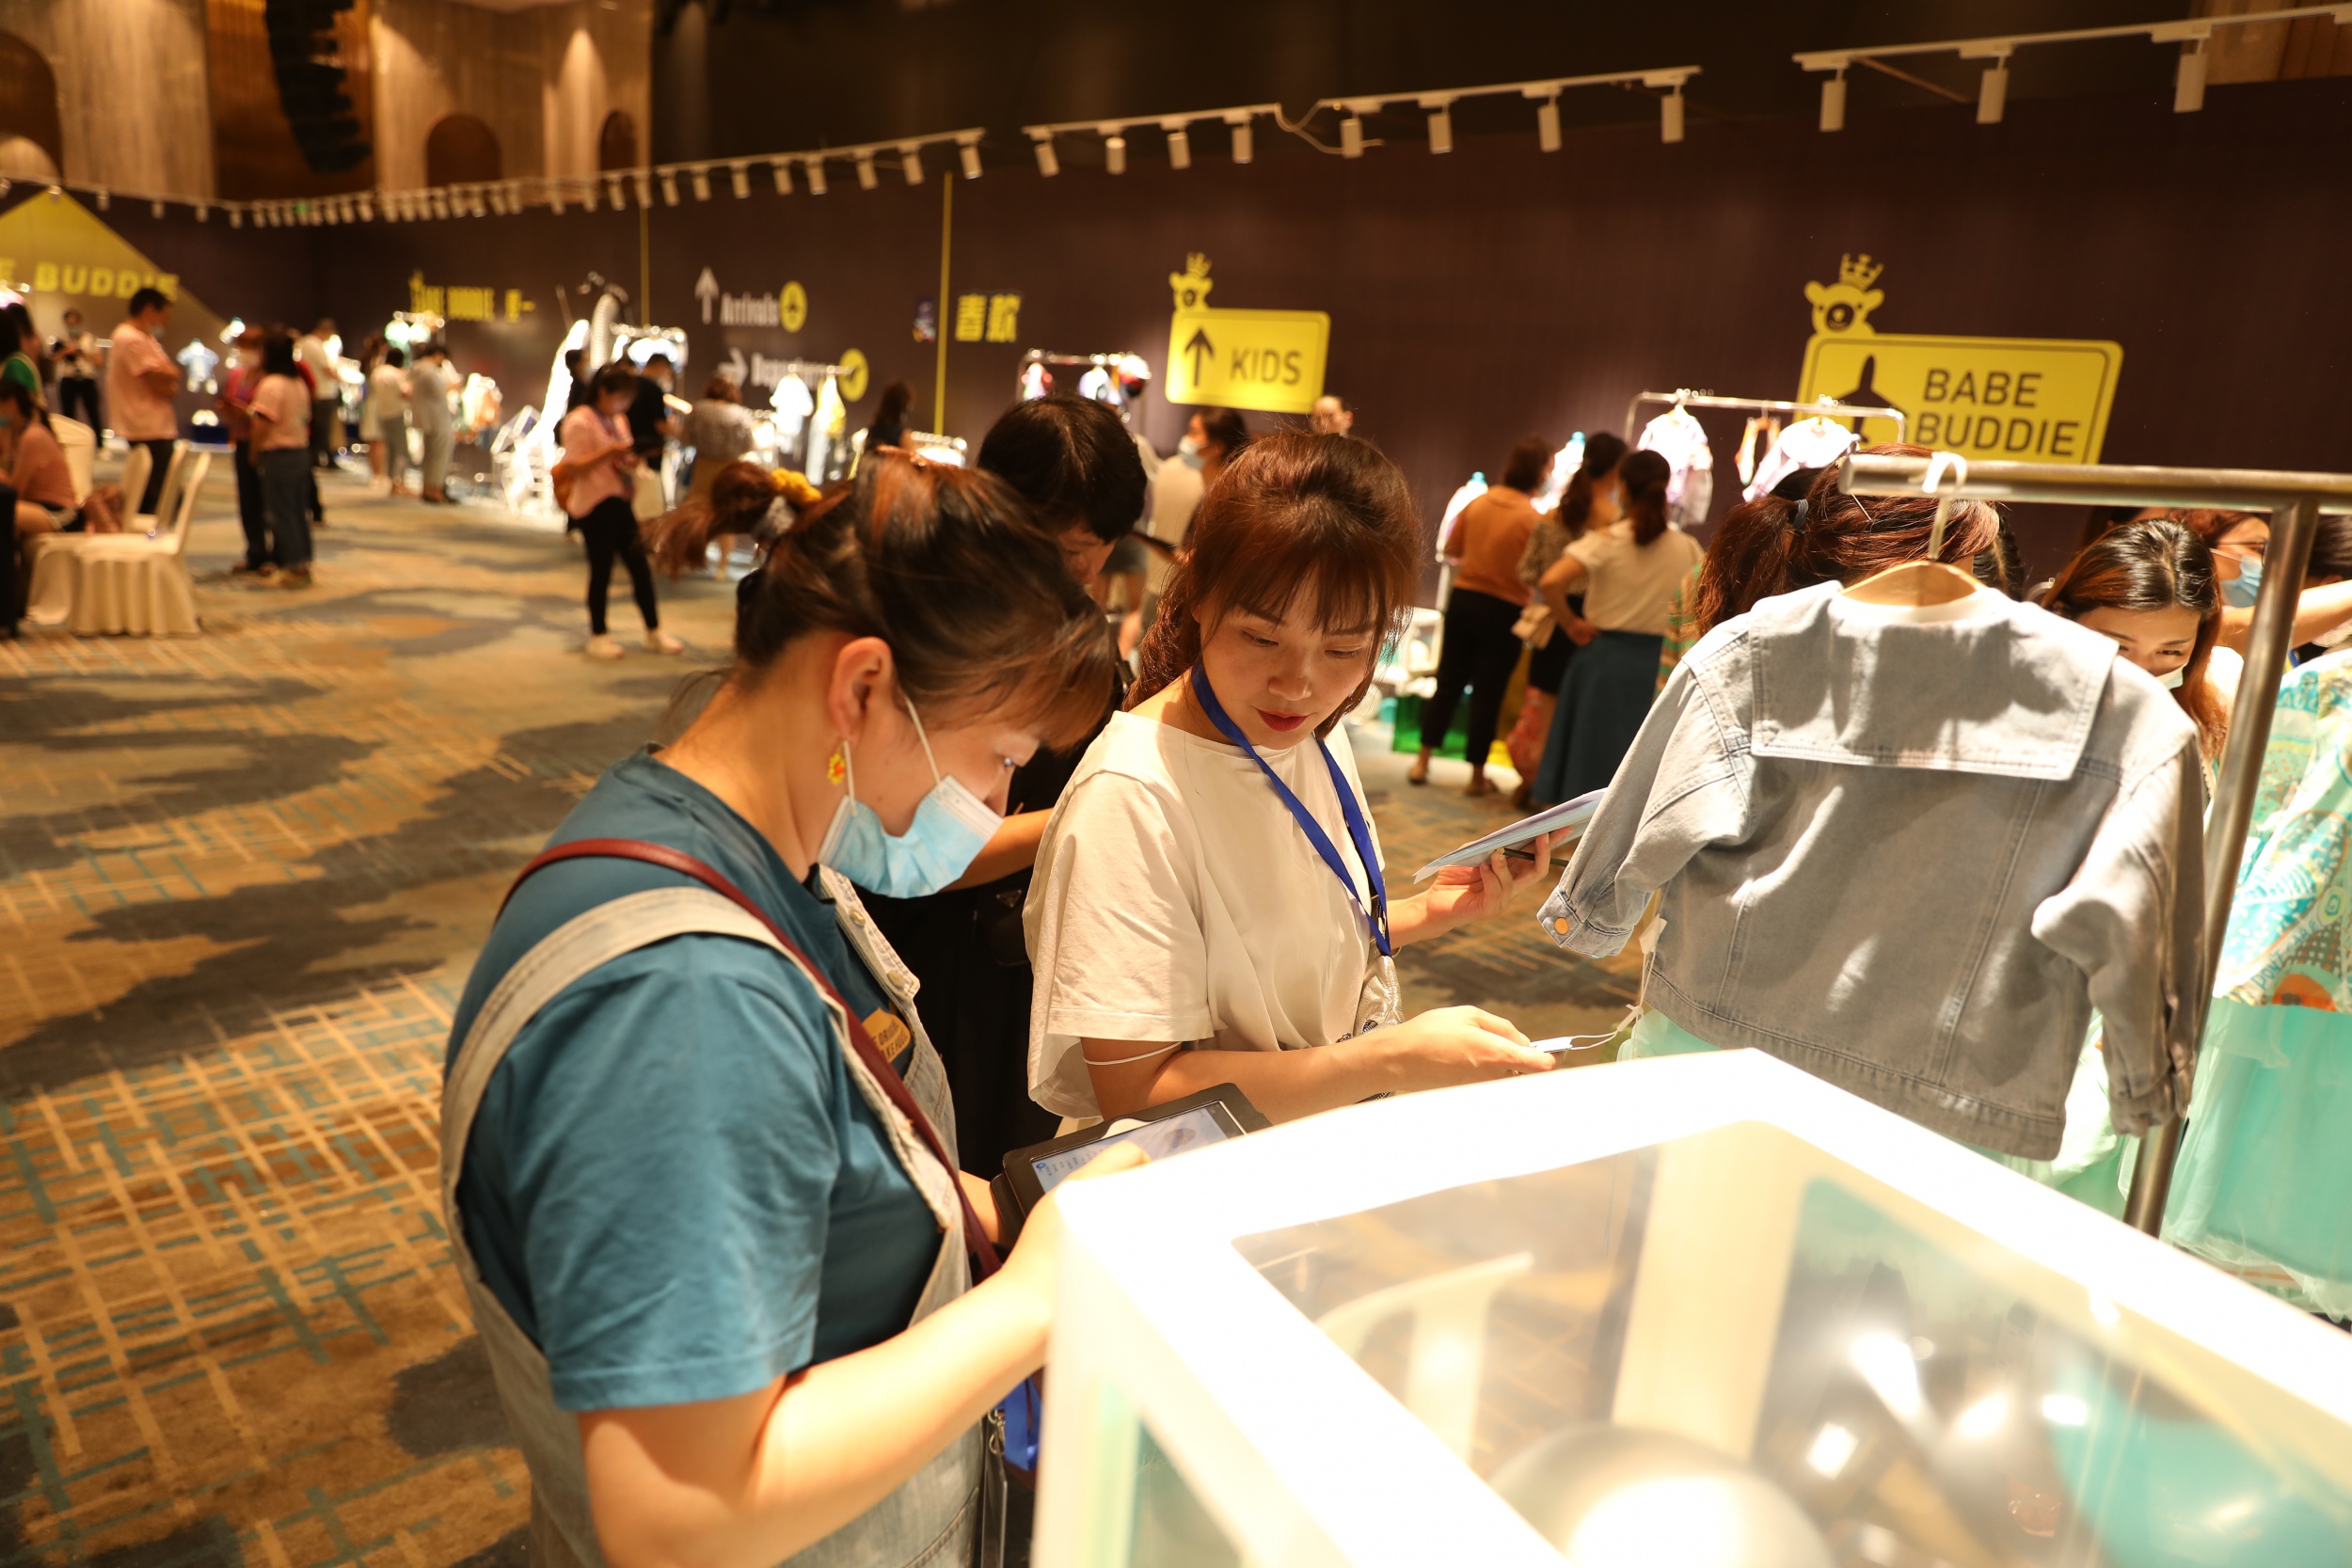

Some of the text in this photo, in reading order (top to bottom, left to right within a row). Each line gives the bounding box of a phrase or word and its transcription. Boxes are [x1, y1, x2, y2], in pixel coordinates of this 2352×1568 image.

[720, 293, 780, 326] Arrivals
[1230, 347, 1302, 386] KIDS
[1924, 368, 2042, 407] BABE
[1915, 411, 2080, 456] BUDDIE
